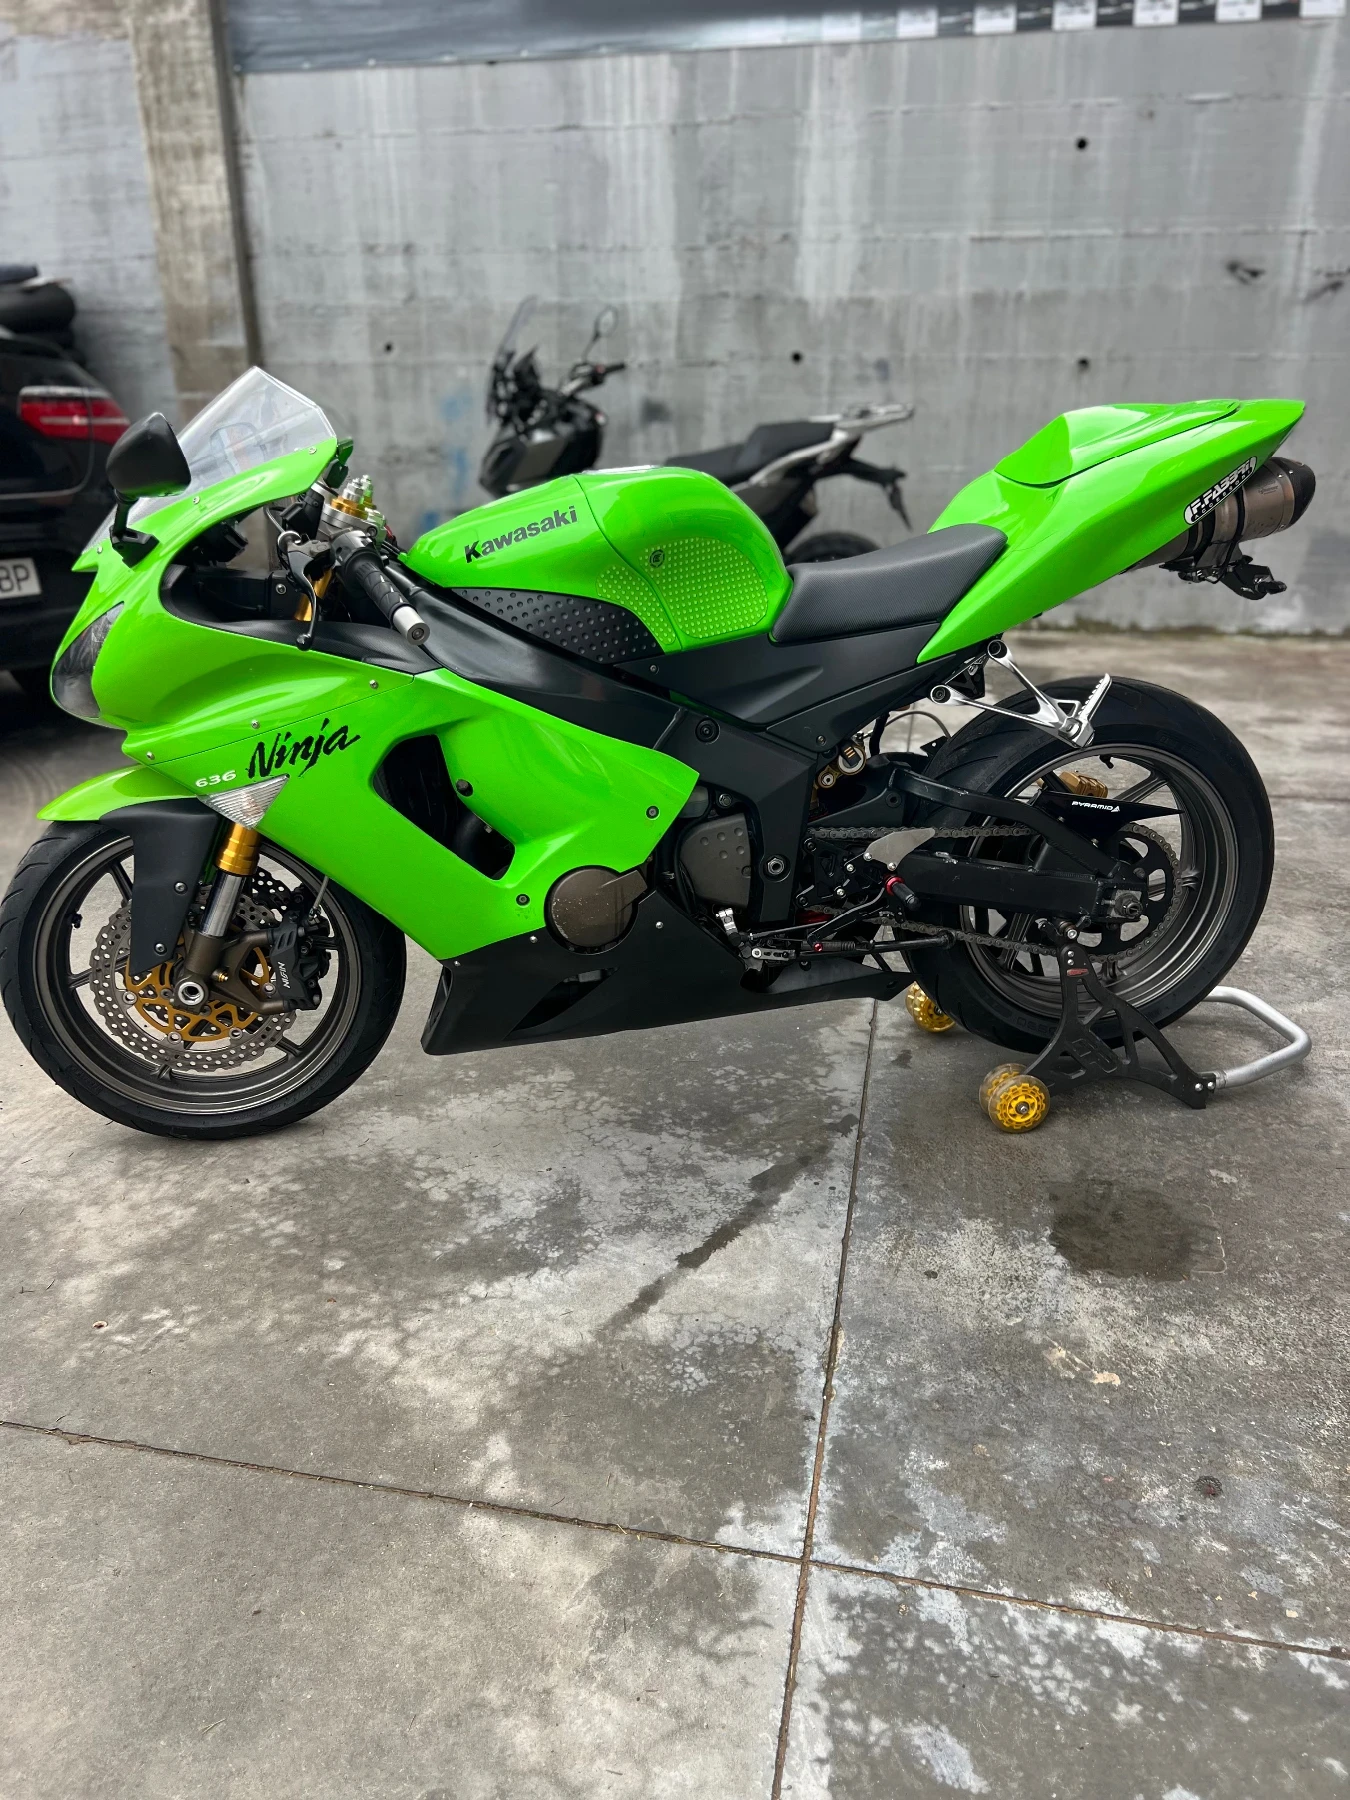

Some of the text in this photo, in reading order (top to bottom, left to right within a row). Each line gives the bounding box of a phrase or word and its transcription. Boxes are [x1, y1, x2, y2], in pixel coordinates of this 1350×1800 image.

[464, 505, 578, 563] Kawasaki
[245, 718, 361, 778] Ninja
[195, 770, 237, 788] 636
[1071, 800, 1114, 811] PYRAMID
